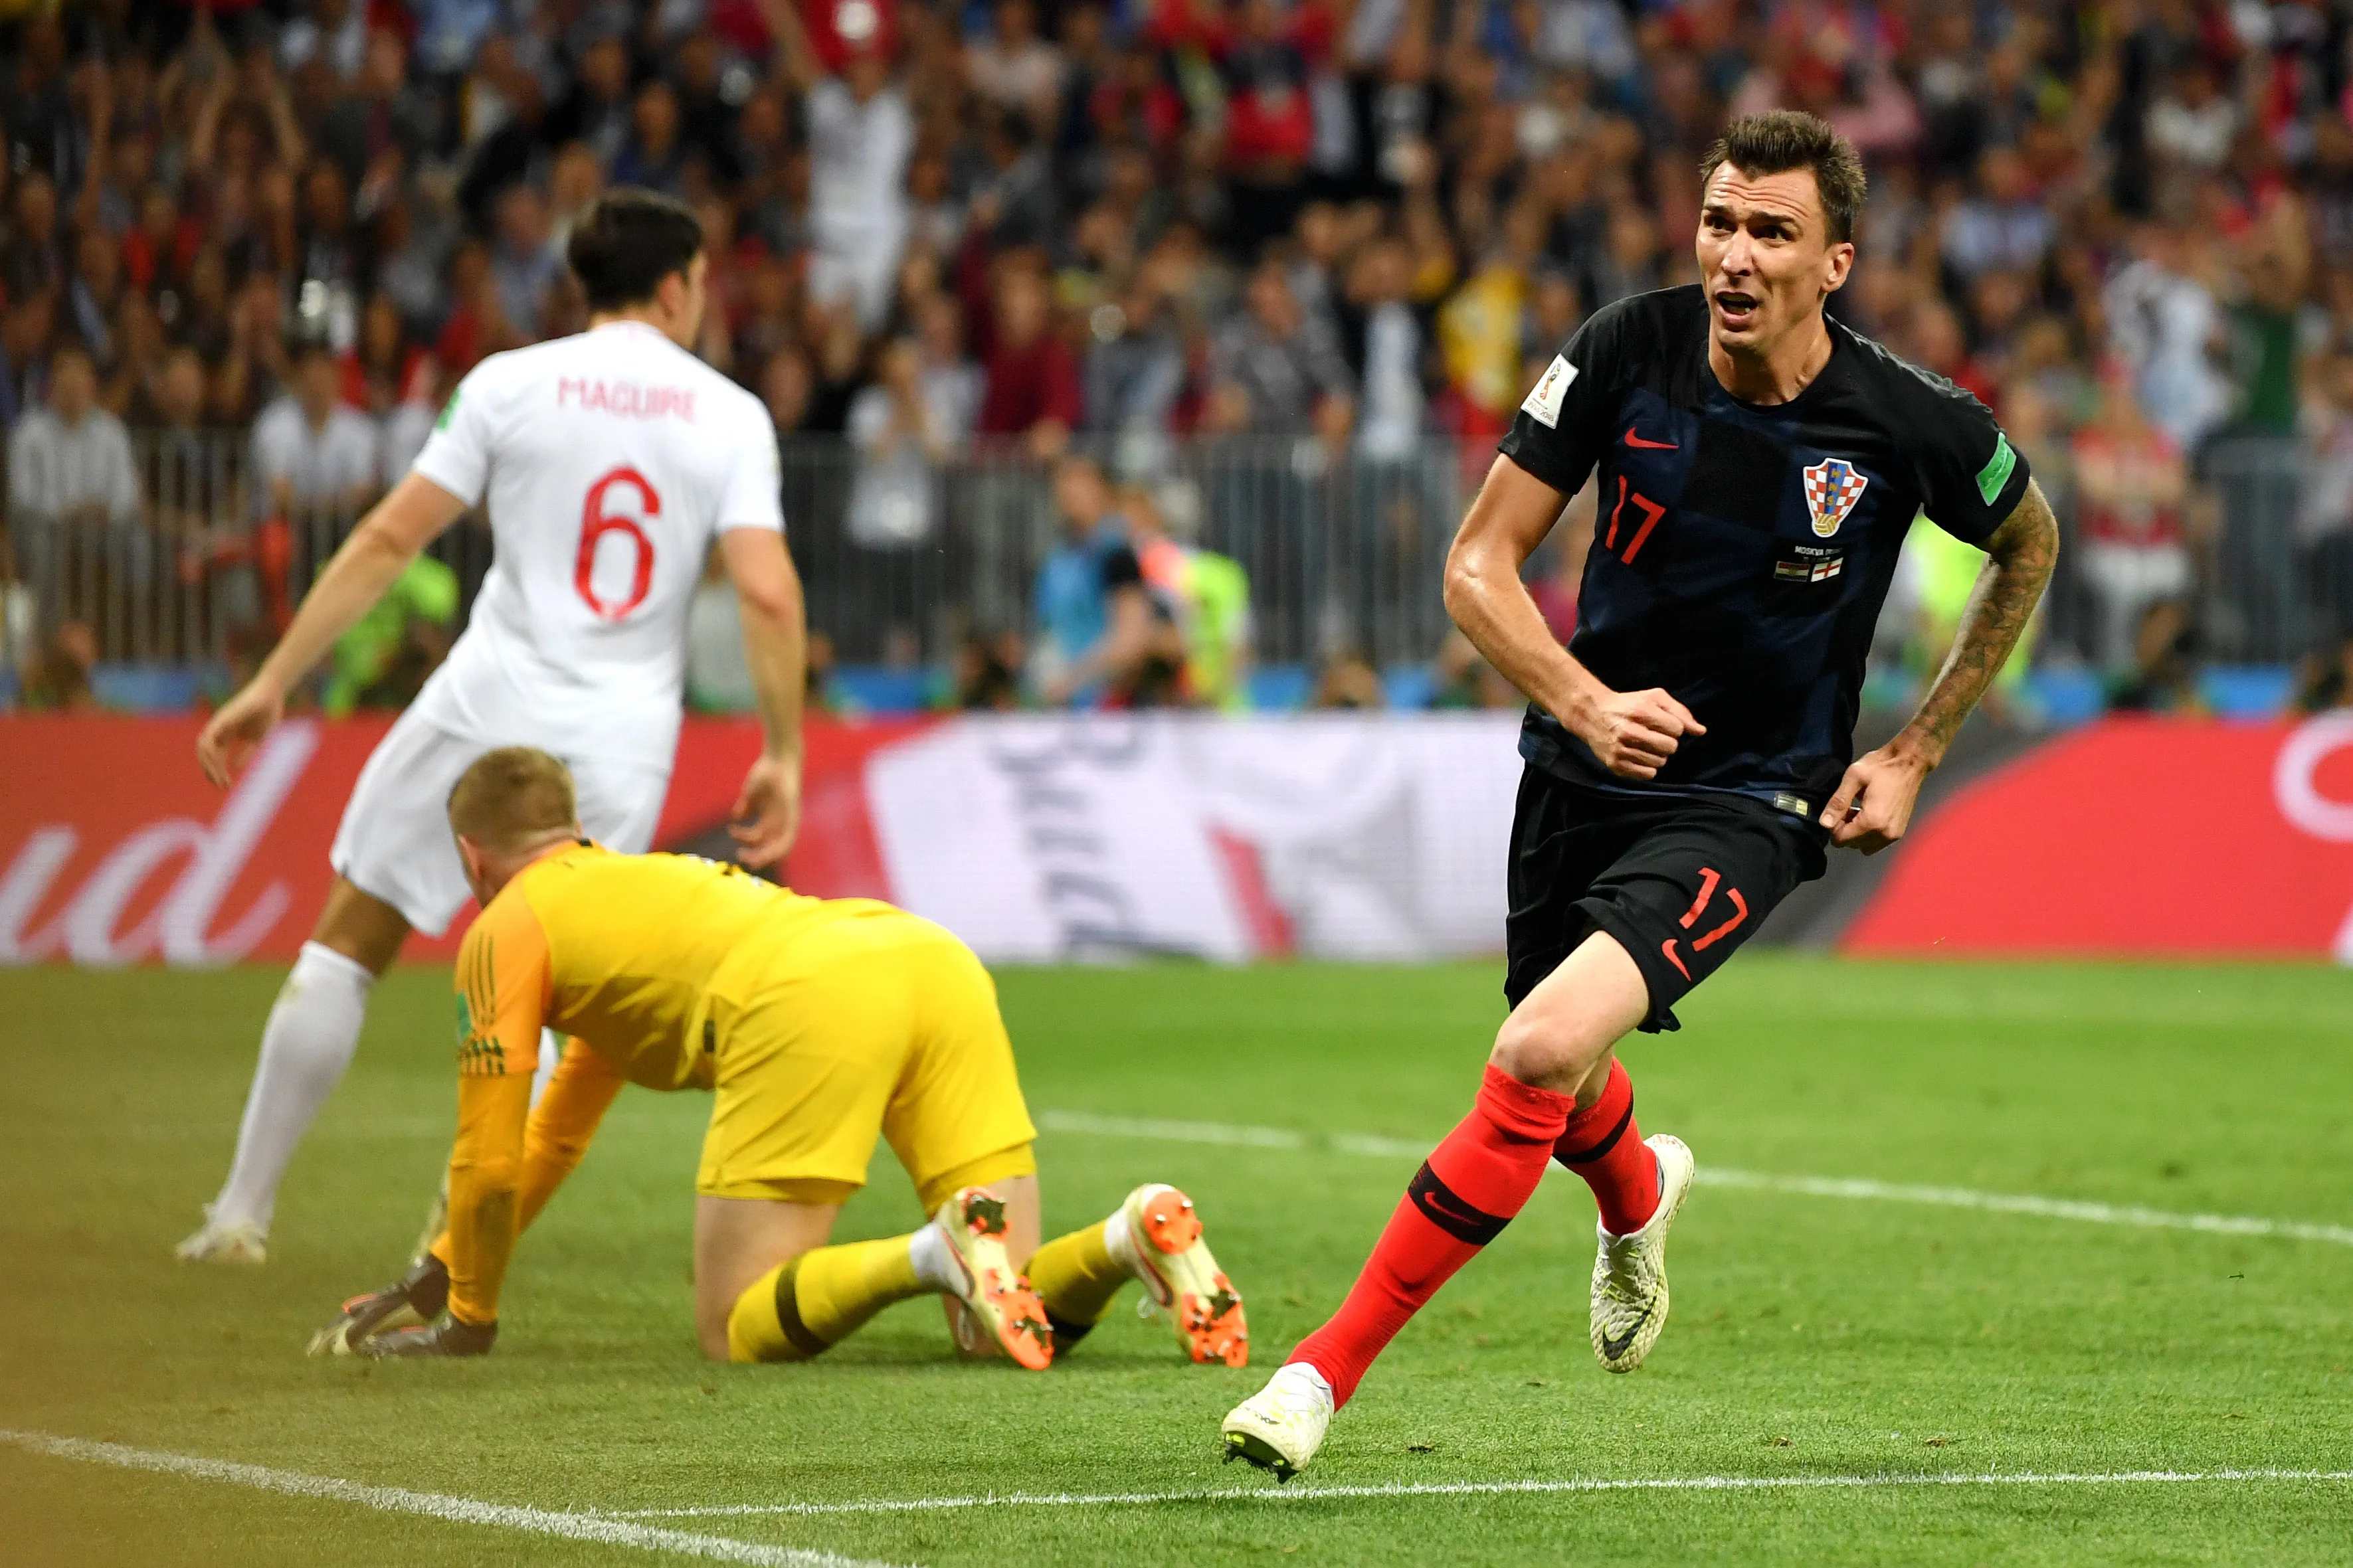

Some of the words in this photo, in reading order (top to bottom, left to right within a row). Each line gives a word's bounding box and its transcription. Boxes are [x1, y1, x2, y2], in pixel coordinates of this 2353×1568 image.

[558, 376, 696, 423] MAGUIRE
[573, 463, 661, 622] 6
[1605, 474, 1667, 565] 17
[1679, 867, 1748, 952] 17
